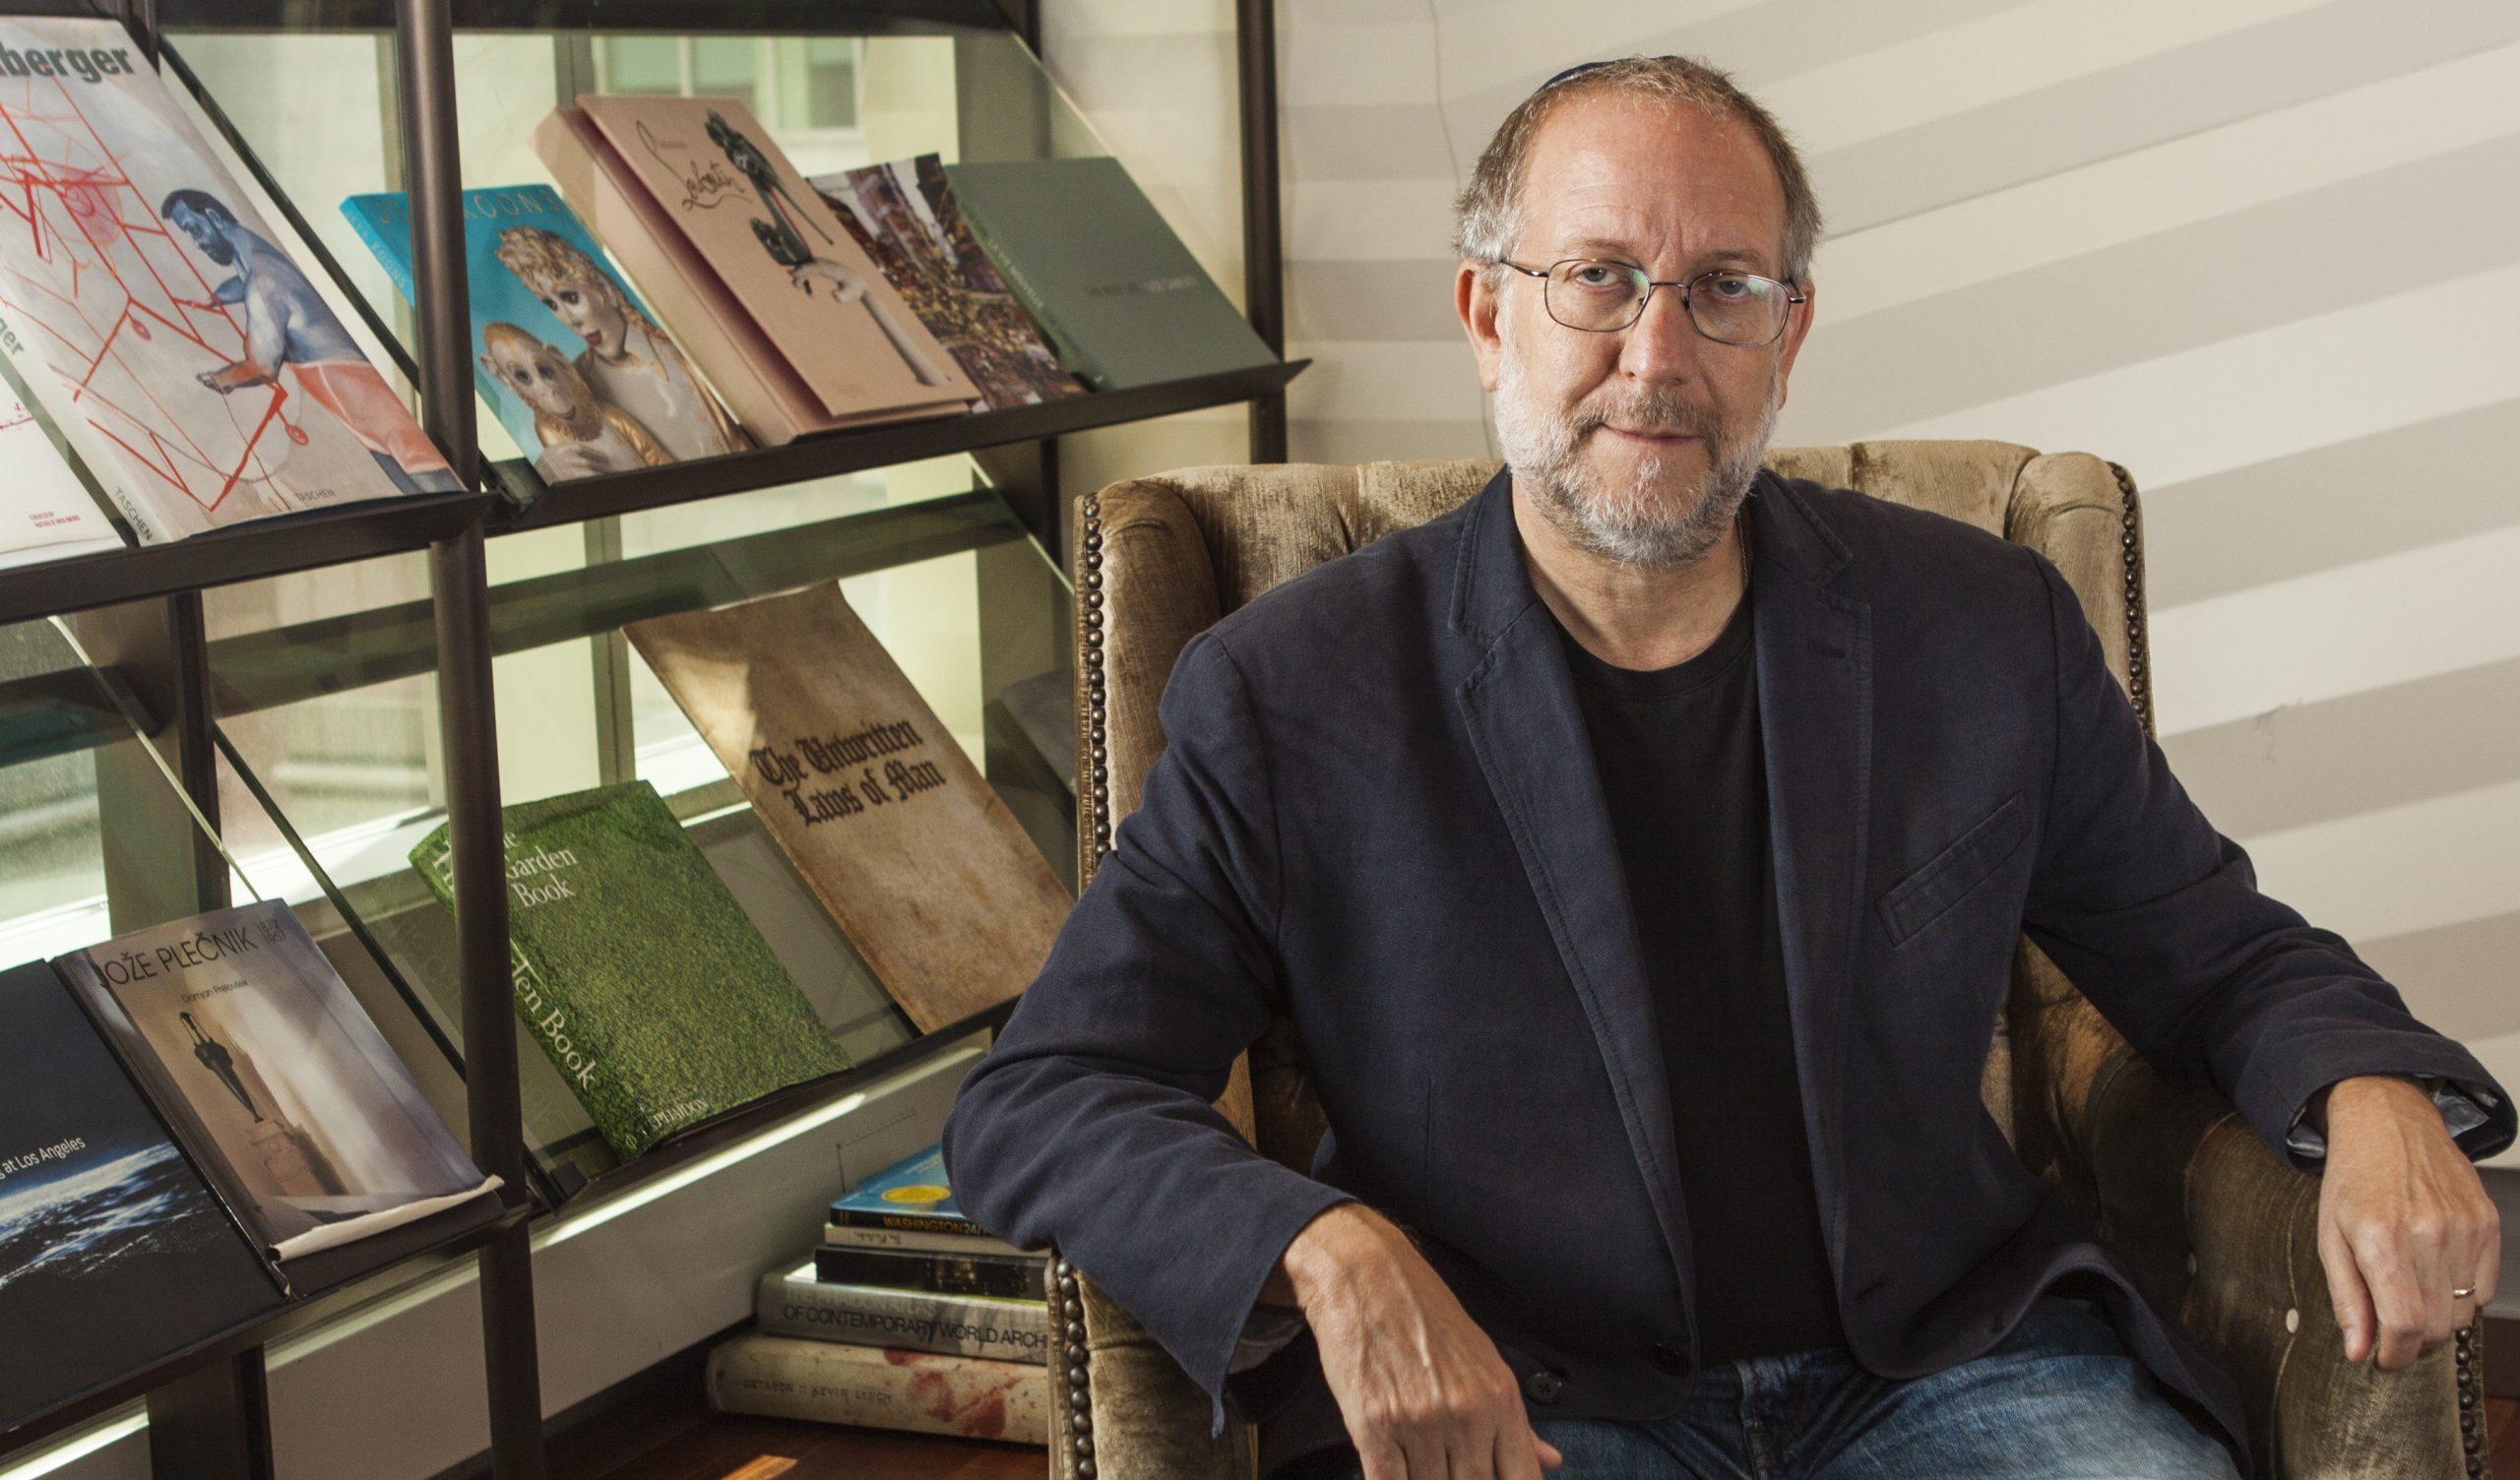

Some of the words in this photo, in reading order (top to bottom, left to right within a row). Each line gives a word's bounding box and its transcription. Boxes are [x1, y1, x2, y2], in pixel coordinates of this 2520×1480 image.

[0, 45, 135, 83] berger
[115, 487, 153, 540] TASCHEN
[749, 747, 808, 790] The
[794, 721, 923, 774] Unwritten
[783, 786, 864, 828] Laws
[860, 768, 891, 806] of
[884, 760, 946, 802] Man
[510, 873, 575, 907] Book
[156, 926, 259, 972] PLEČNIK
[540, 1007, 598, 1091] Book
[2, 1158, 19, 1174] at
[14, 1153, 40, 1169] Los
[39, 1137, 86, 1160] Angeles
[784, 1305, 805, 1322] OF
[806, 1307, 938, 1340] CONTEMPORARY
[939, 1321, 998, 1344] WORLD
[999, 1328, 1047, 1349] ARCH
